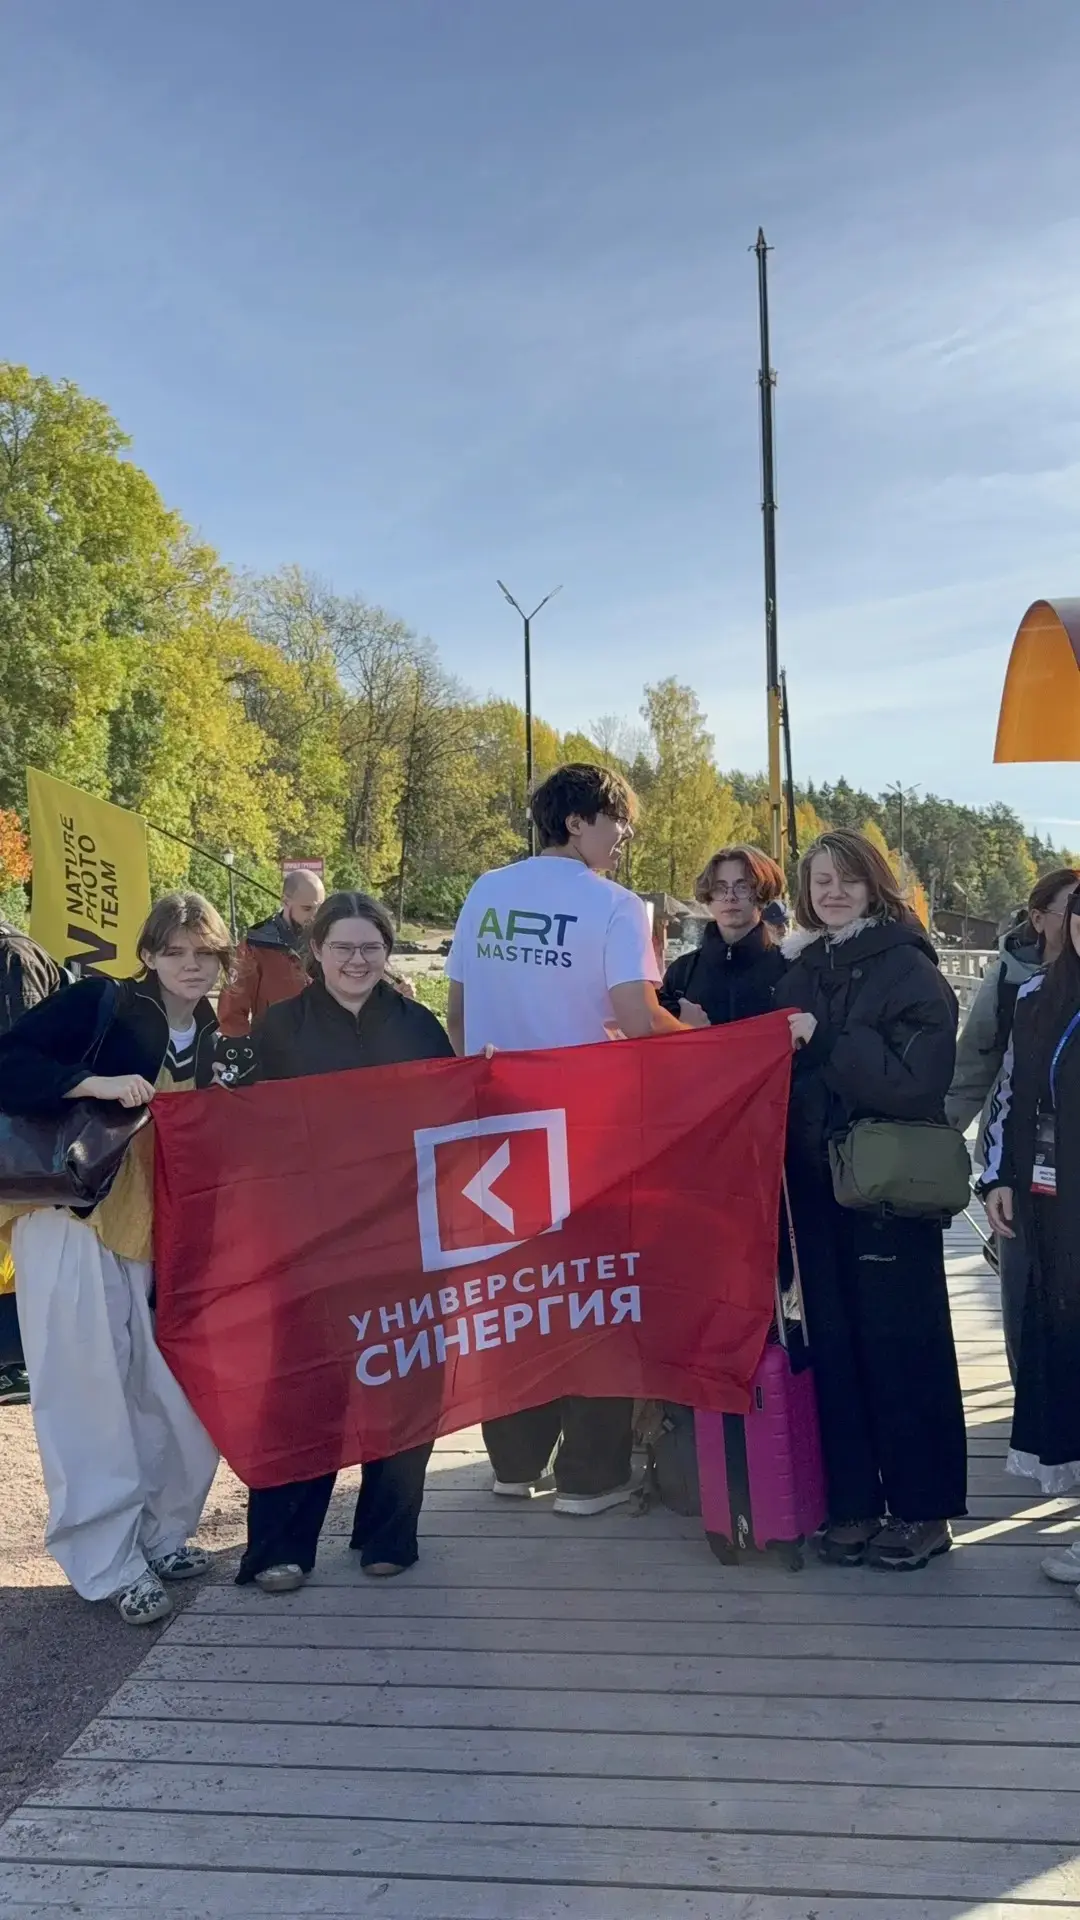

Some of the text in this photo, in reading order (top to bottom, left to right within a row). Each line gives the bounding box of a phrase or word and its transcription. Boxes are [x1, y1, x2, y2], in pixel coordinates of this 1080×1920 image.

[61, 814, 83, 915] NATURE
[78, 835, 98, 925] PHOTO
[100, 859, 119, 929] TEAM
[476, 942, 572, 968] MASTERS
[477, 907, 578, 946] ART
[348, 1252, 641, 1342] УНИВЕРСИТЕТ
[355, 1285, 642, 1386] СИНЕРГИЯ
